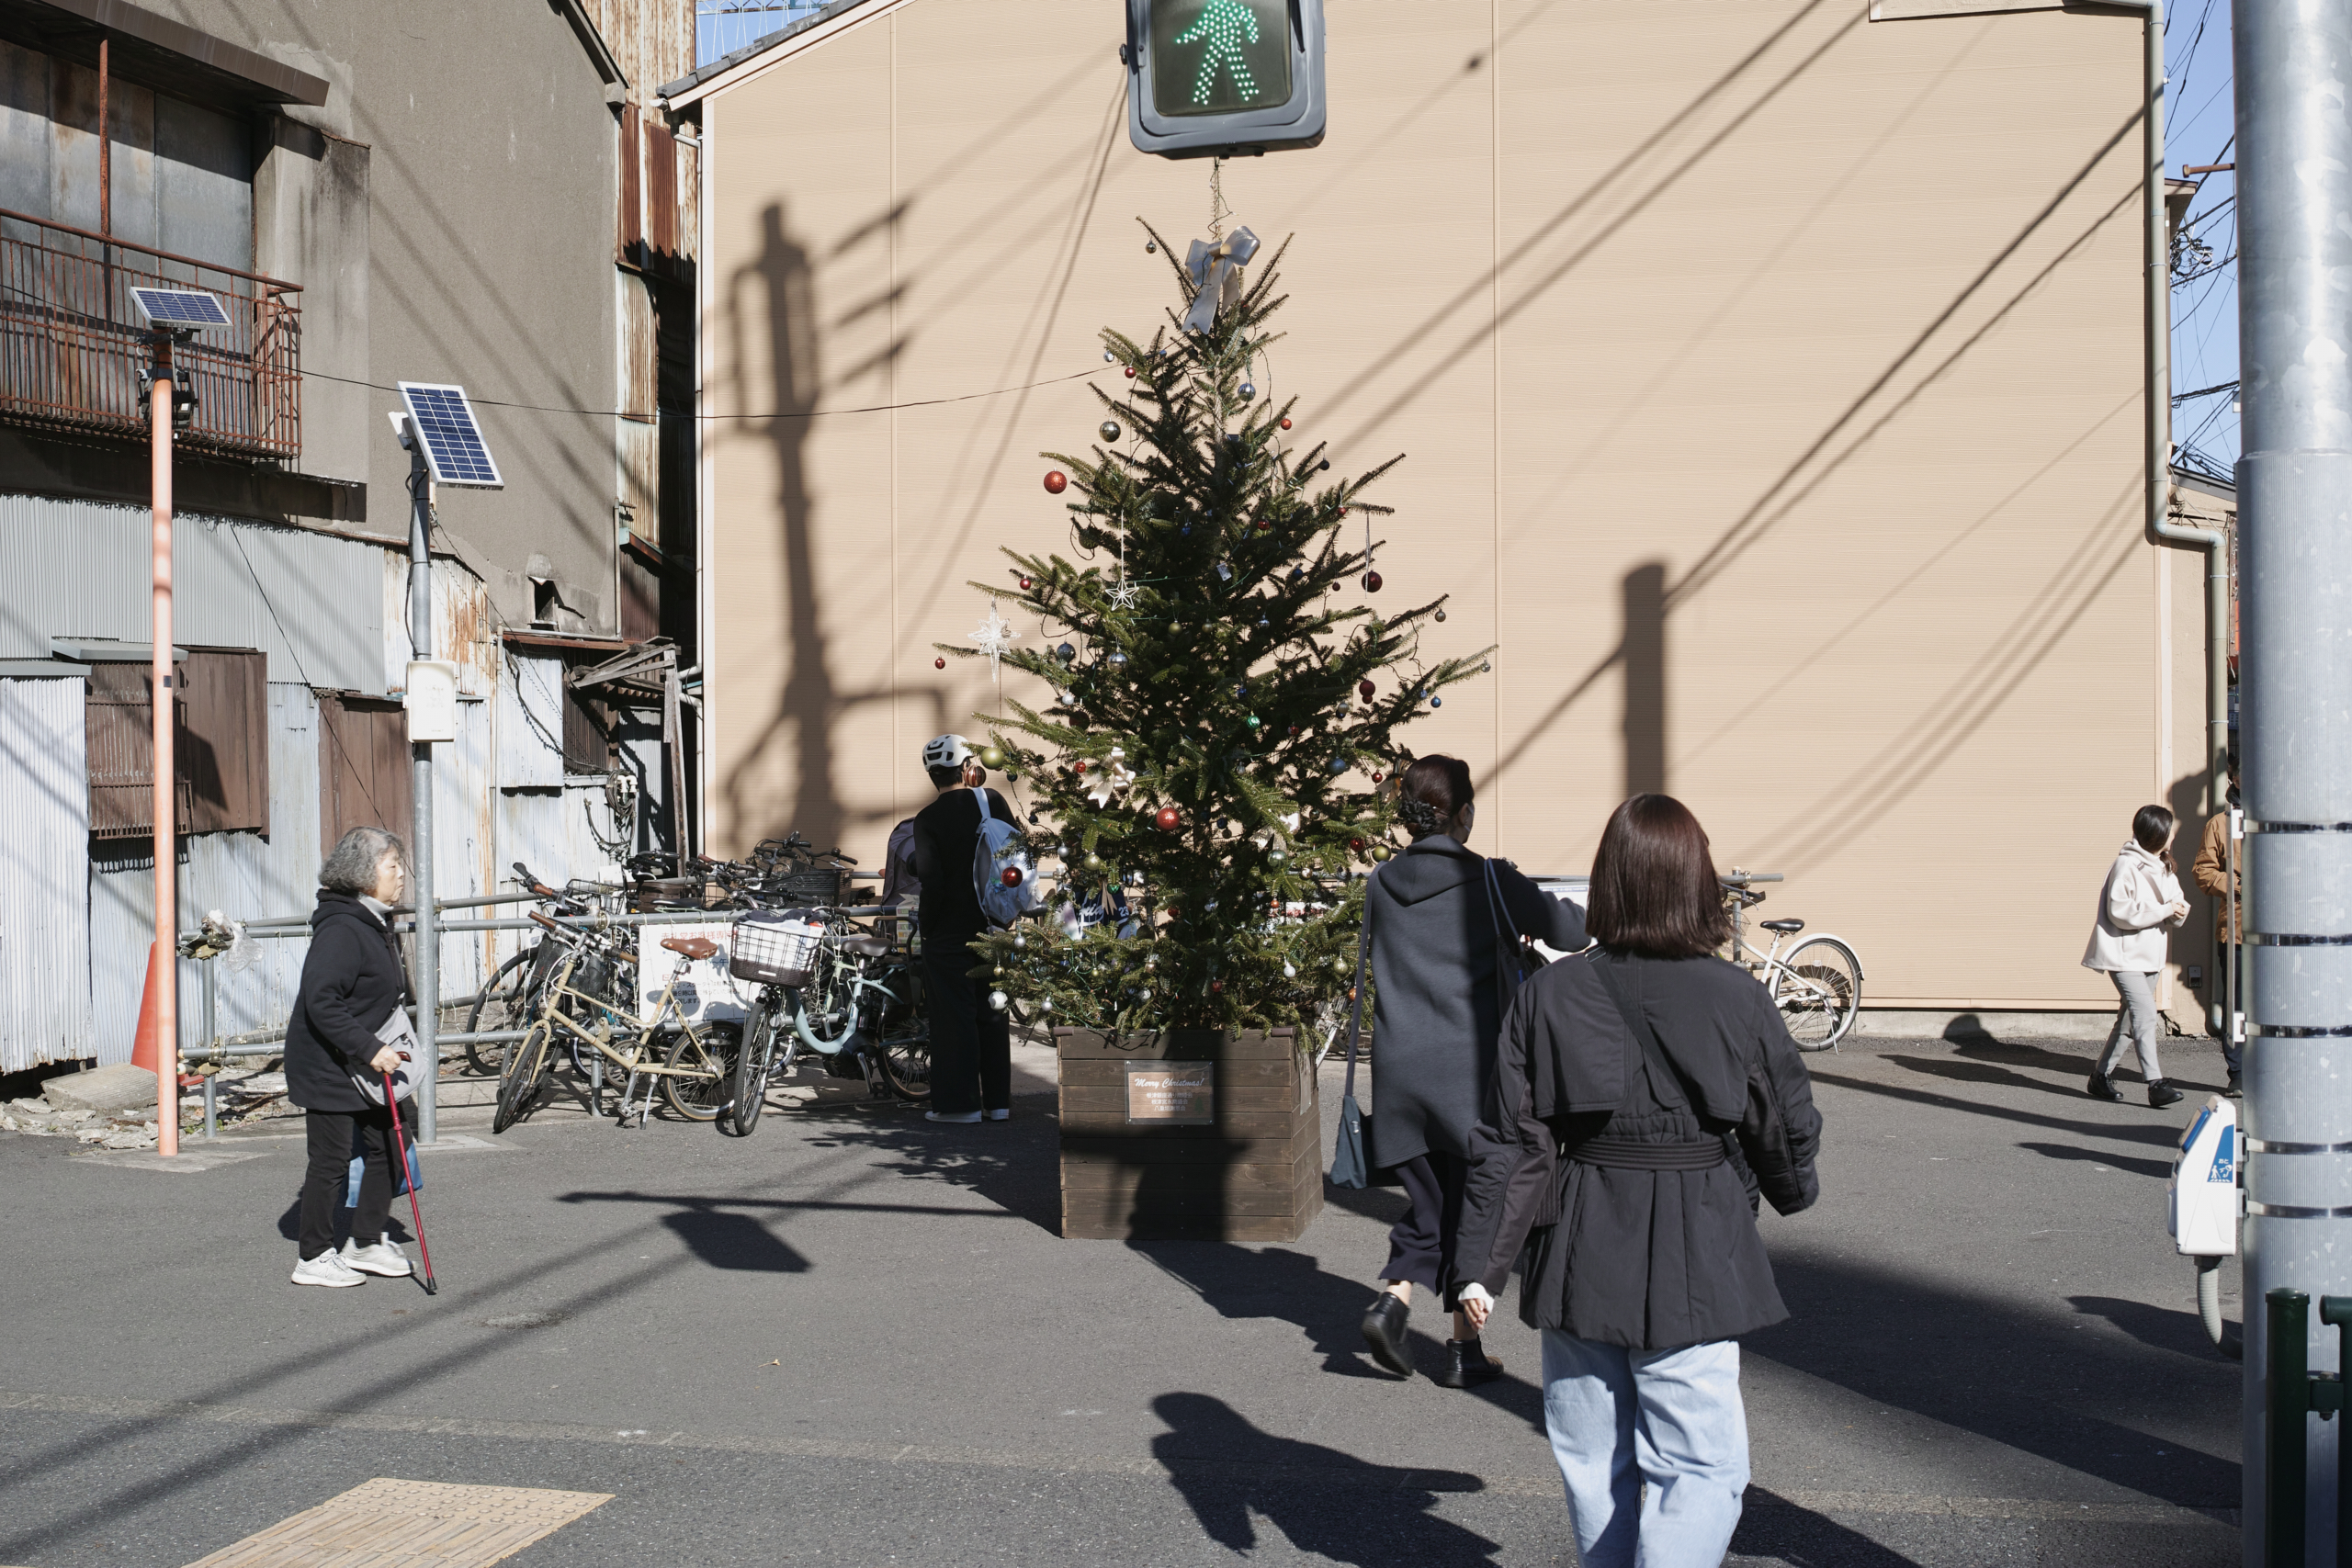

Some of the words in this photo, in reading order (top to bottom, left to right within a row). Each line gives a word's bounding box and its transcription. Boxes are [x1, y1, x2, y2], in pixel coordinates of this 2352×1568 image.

[1118, 906, 1129, 918] 23
[1134, 1077, 1159, 1089] Merry
[1161, 1077, 1204, 1089] Christmas!
